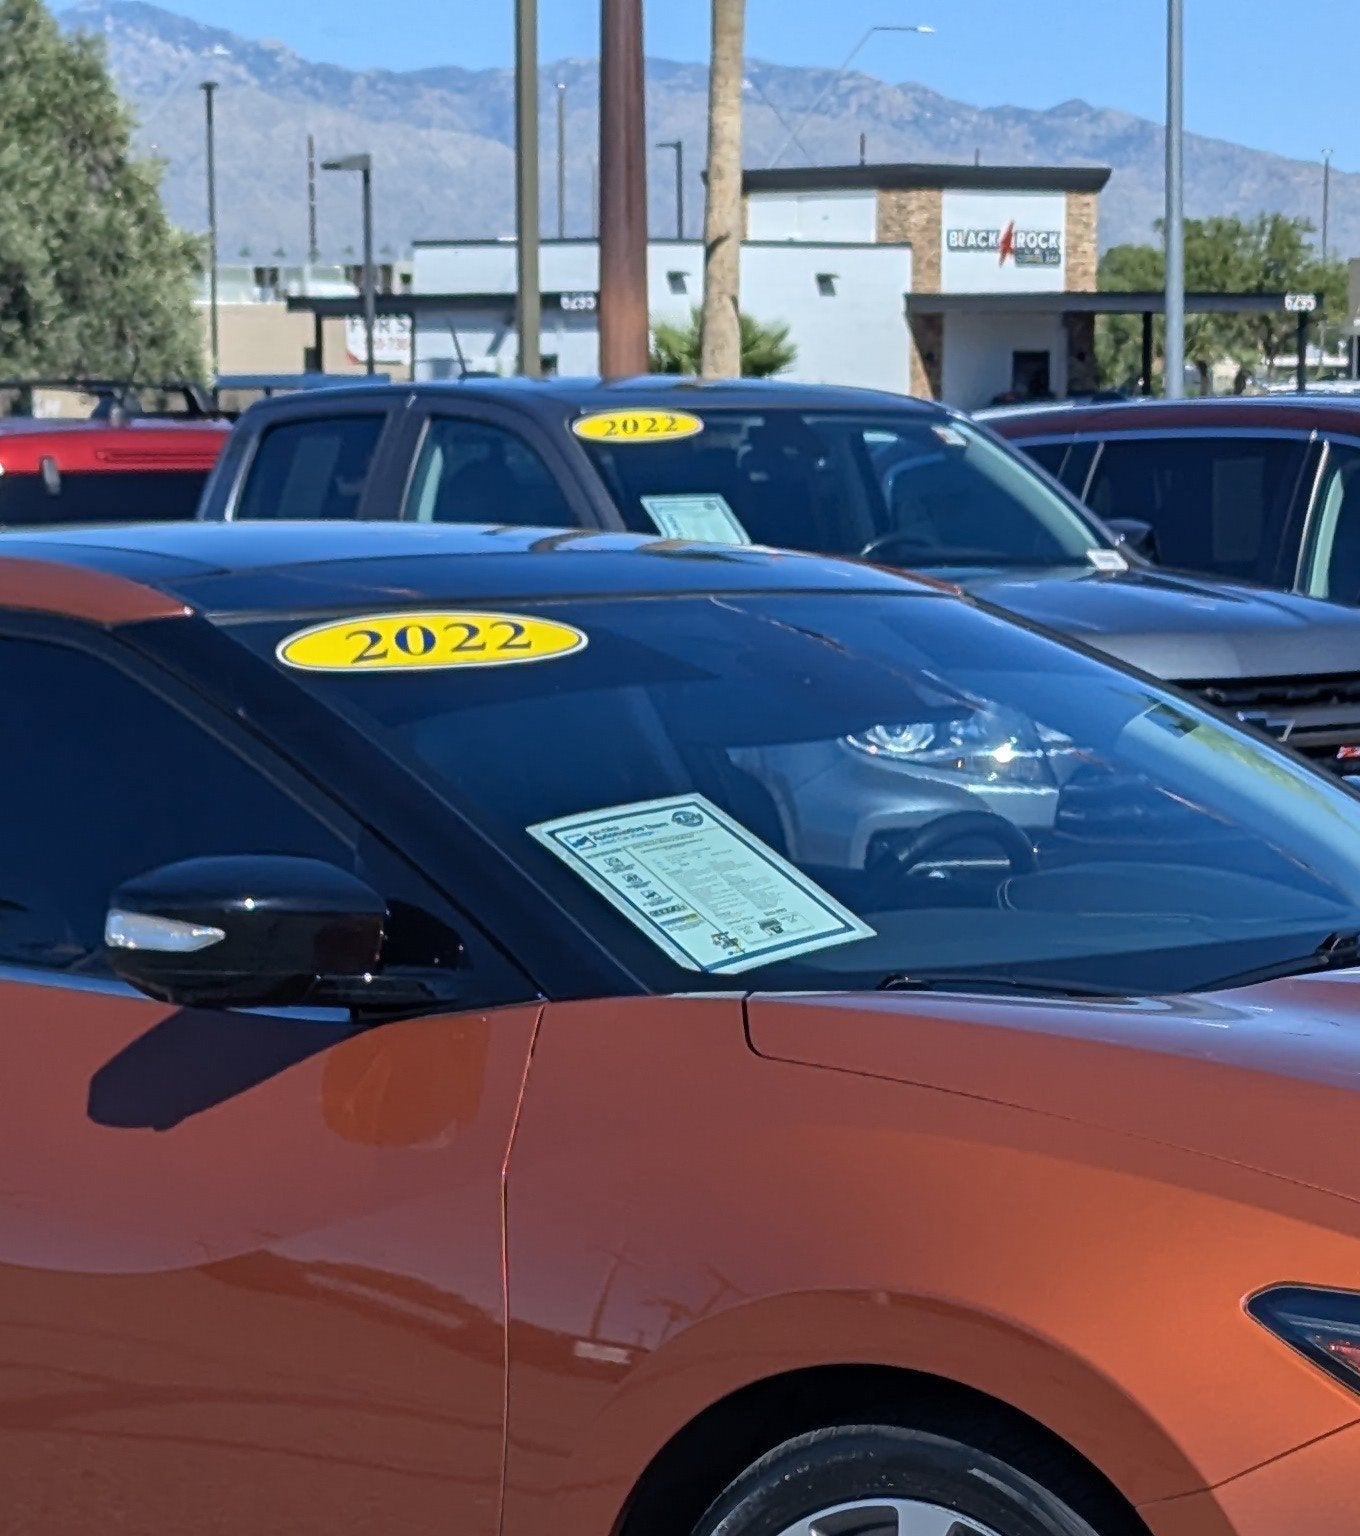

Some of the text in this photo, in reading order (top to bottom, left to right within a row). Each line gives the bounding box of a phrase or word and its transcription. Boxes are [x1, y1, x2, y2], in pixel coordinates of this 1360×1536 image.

[949, 231, 1058, 249] BLACK ROCK
[603, 416, 678, 437] 2022
[345, 621, 532, 664] 2022
